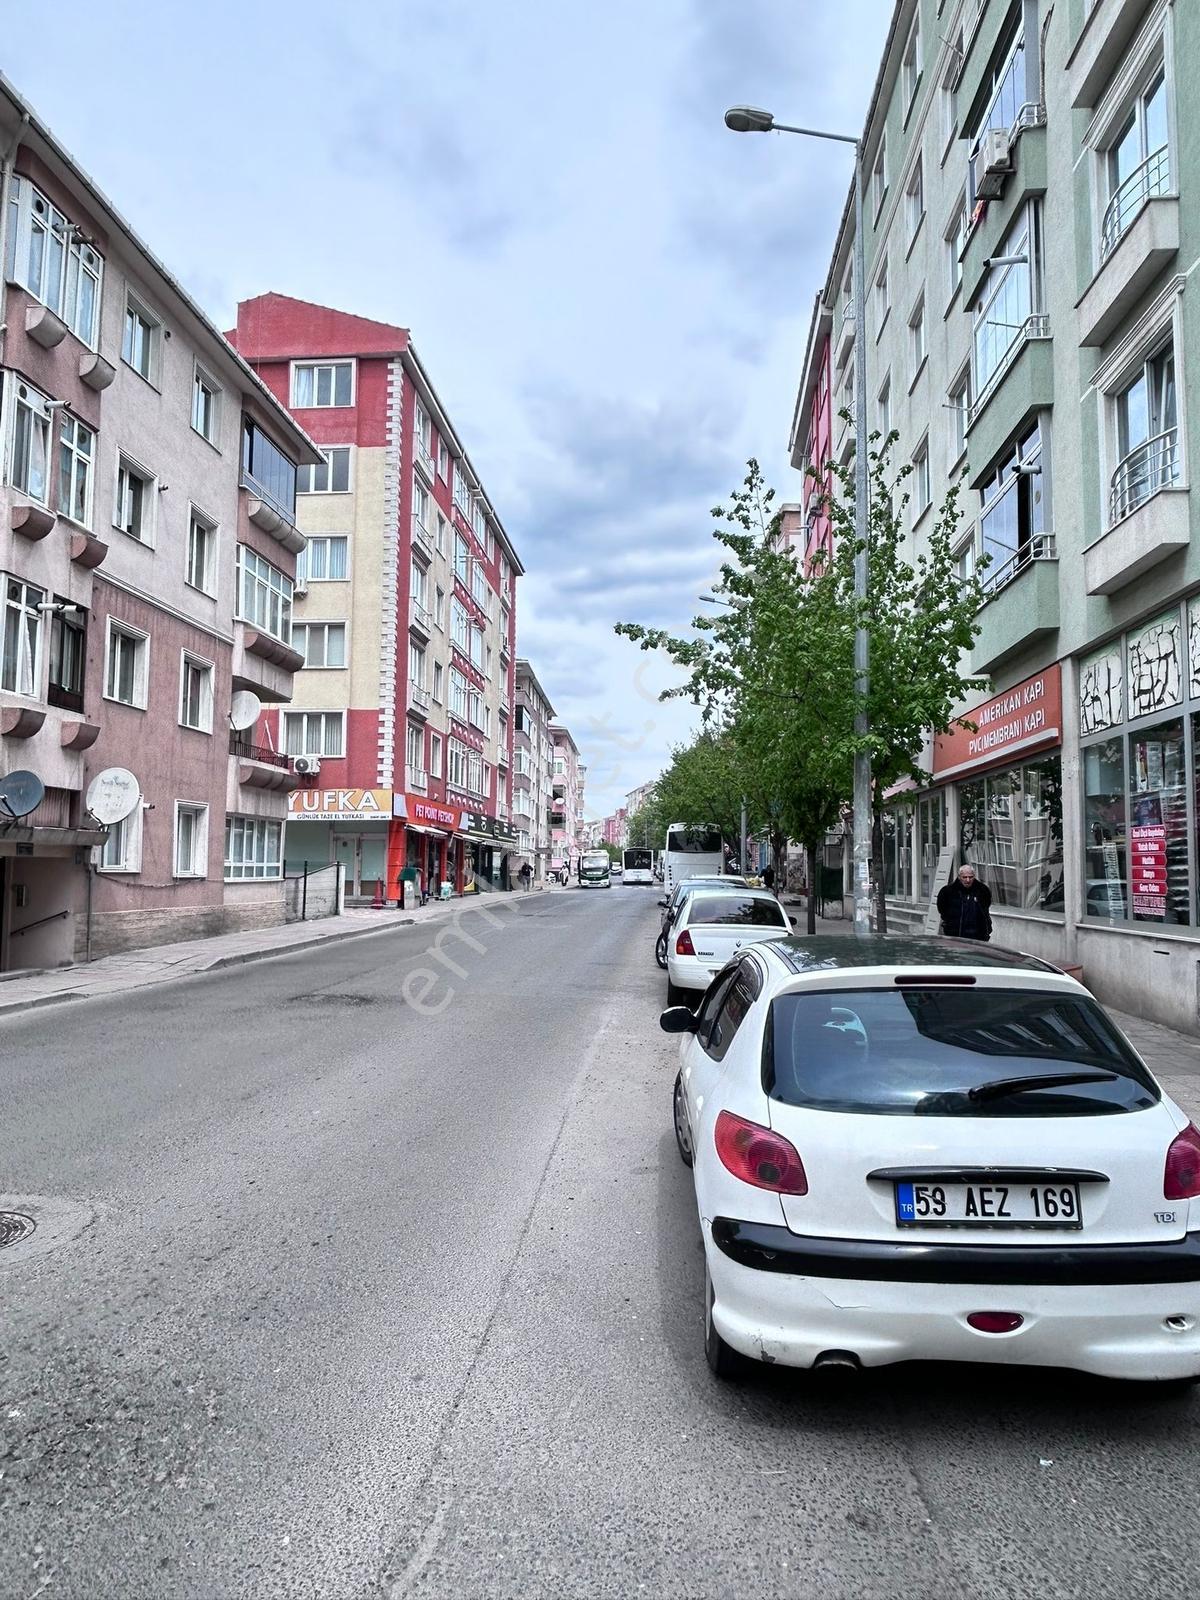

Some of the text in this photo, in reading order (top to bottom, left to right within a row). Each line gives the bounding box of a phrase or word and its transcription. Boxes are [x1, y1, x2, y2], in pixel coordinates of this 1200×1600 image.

[1024, 679, 1044, 704] KAPI
[969, 708, 1045, 755] PVC(MEMBRAN) KAPI
[288, 791, 379, 811] YUFKA
[415, 803, 424, 818] PET
[901, 1203, 913, 1212] TR
[915, 1186, 1075, 1217] 59 AEZ 169
